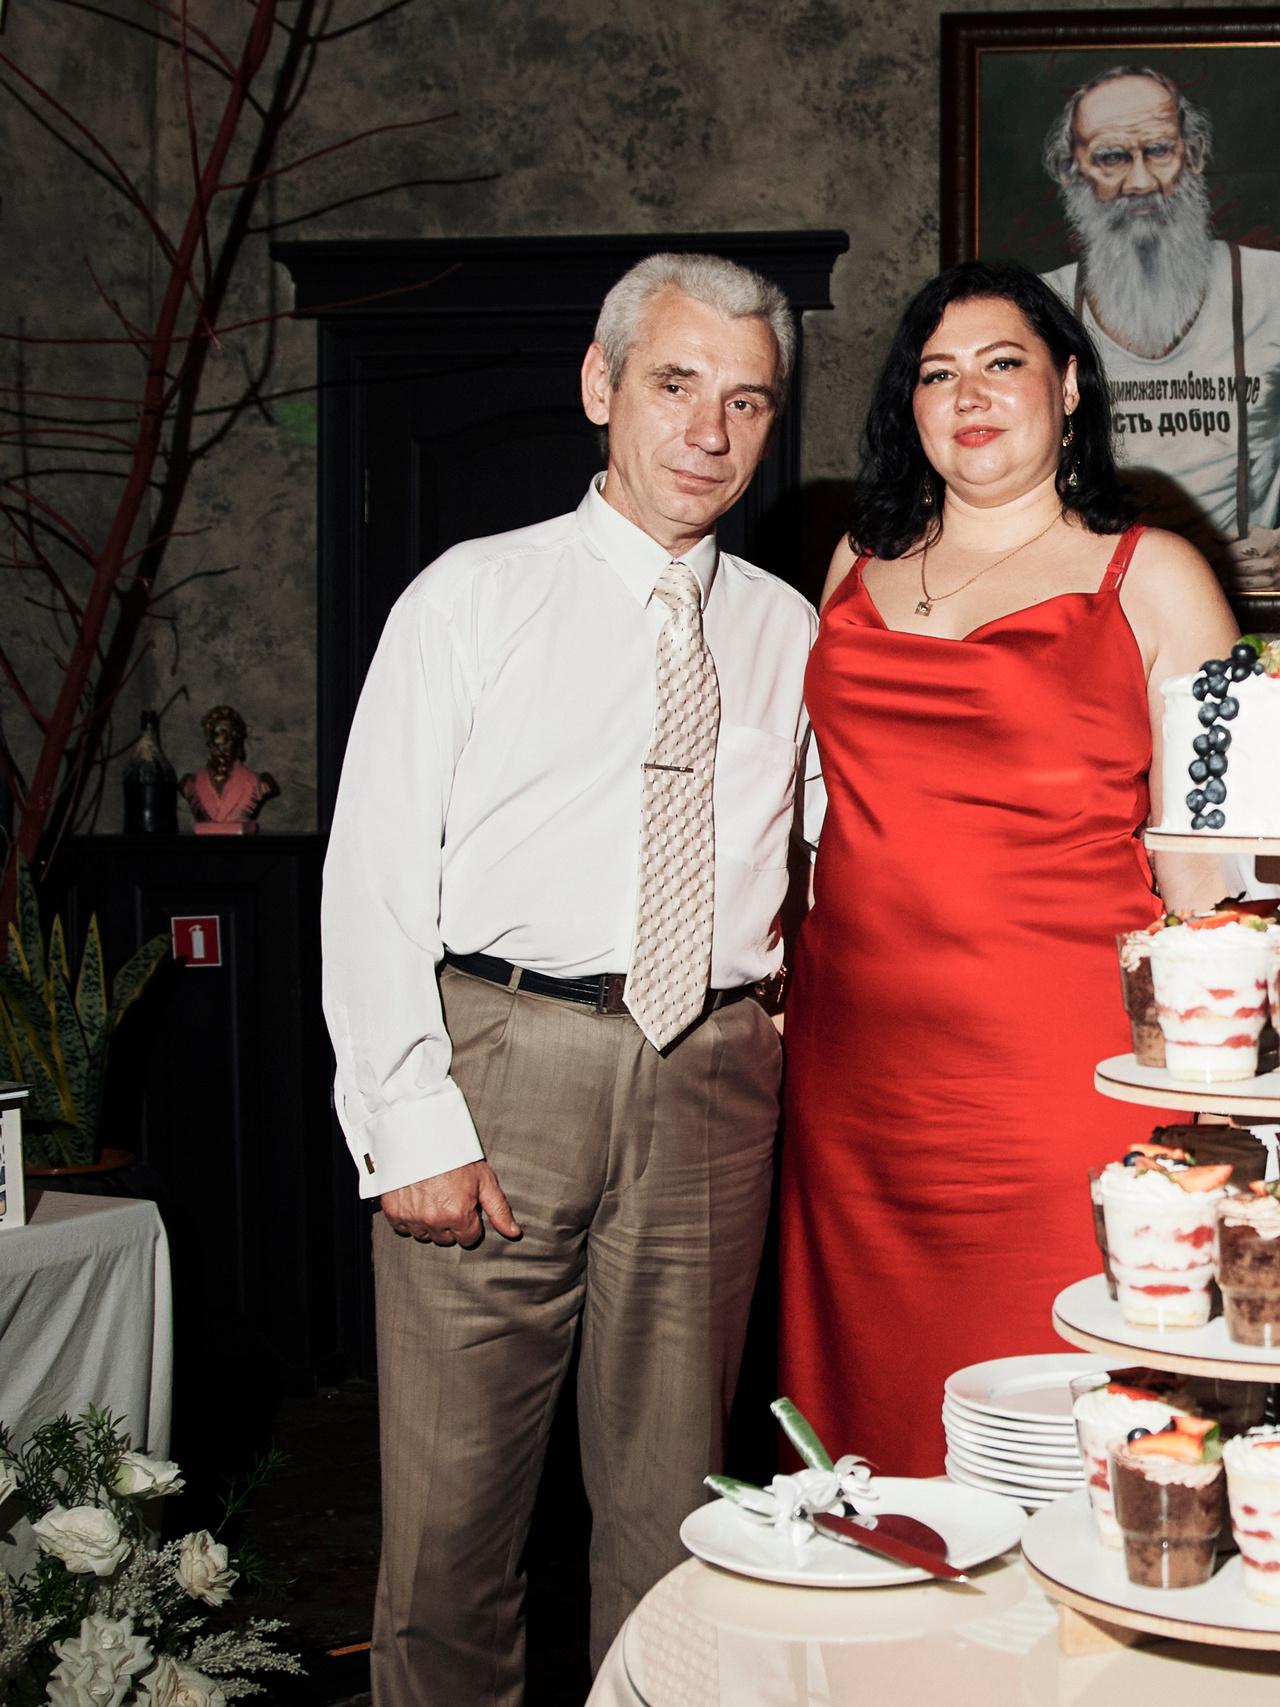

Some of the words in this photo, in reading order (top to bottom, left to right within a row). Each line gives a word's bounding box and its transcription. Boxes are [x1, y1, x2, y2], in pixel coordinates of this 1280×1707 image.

[1170, 370, 1216, 400] любовь
[1219, 377, 1226, 401] в
[1229, 376, 1260, 404] мре
[1113, 412, 1153, 434] сть
[1158, 408, 1231, 437] добро
